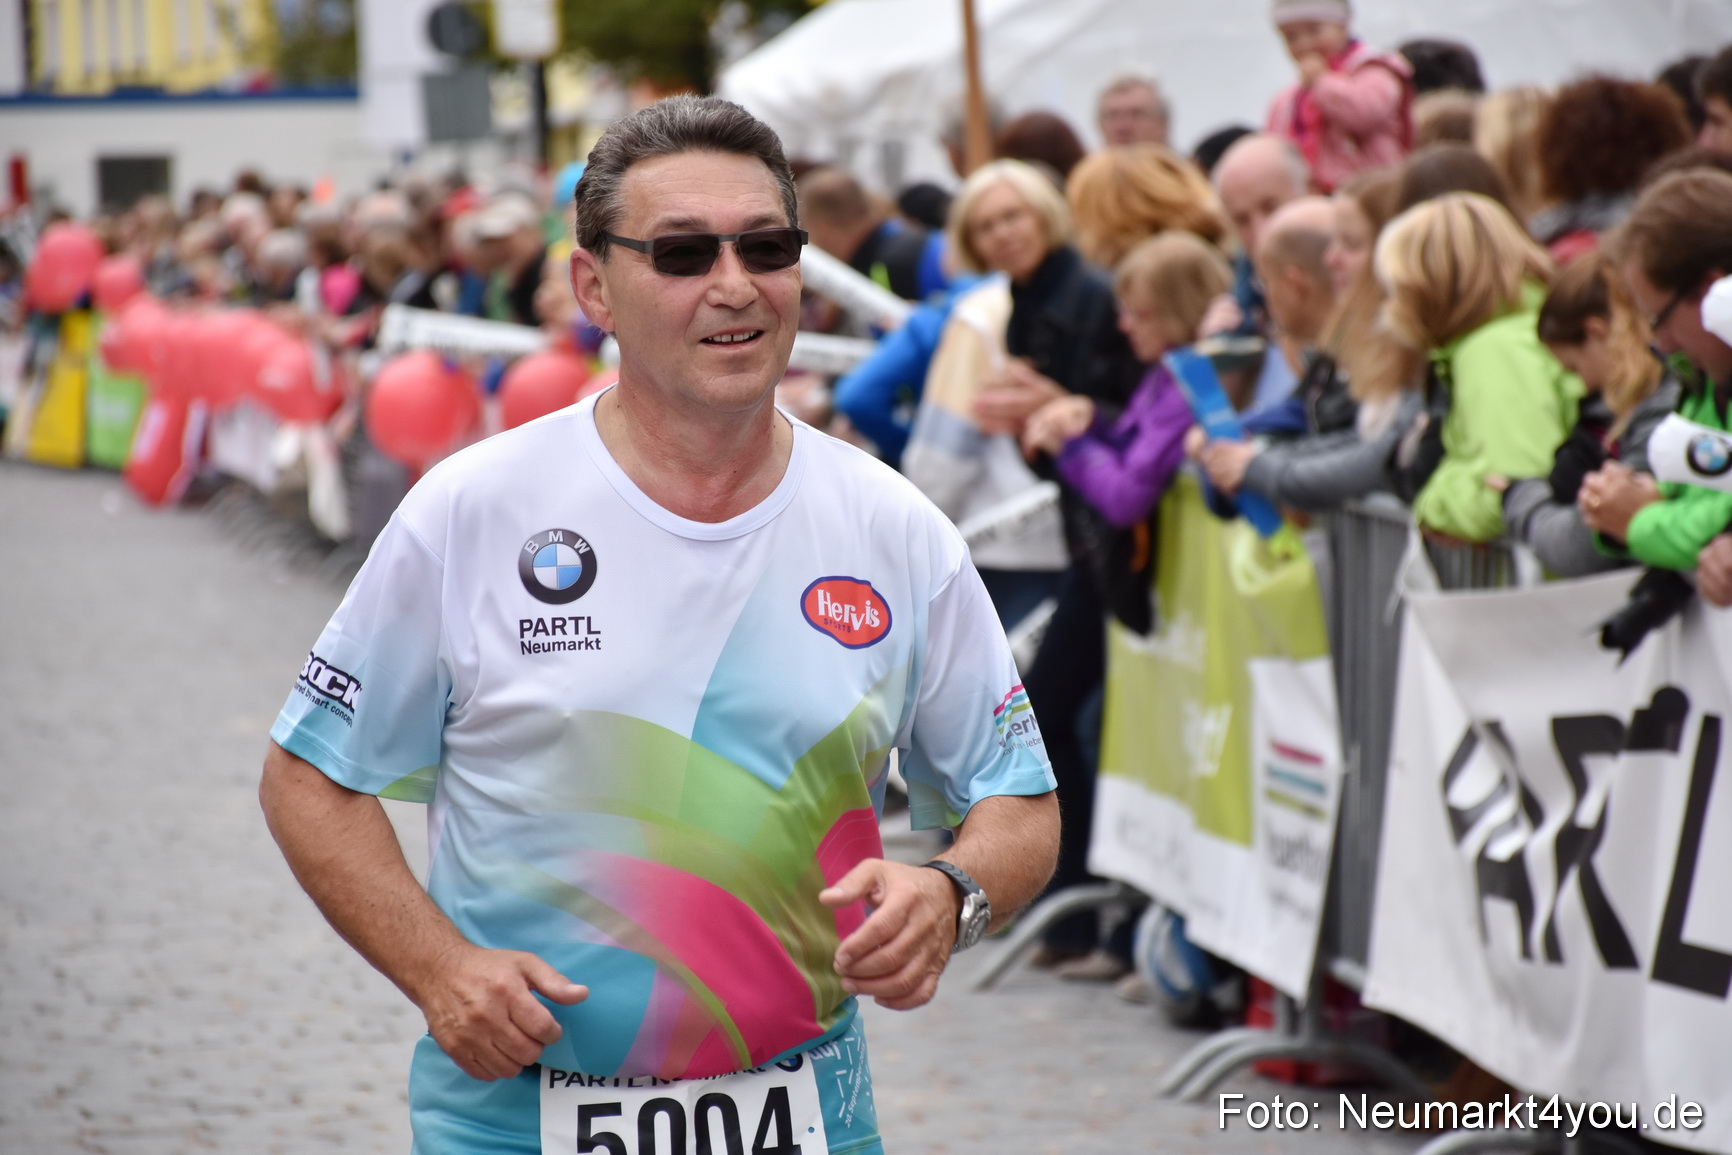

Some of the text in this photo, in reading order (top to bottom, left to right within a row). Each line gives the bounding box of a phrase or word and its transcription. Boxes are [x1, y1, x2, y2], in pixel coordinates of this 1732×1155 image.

[524, 530, 591, 555] BMW
[817, 588, 880, 631] Hervis
[519, 616, 601, 639] PARTL
[823, 618, 851, 633] SPORTS
[520, 637, 602, 655] Neumarkt
[577, 1086, 803, 1155] 5004
